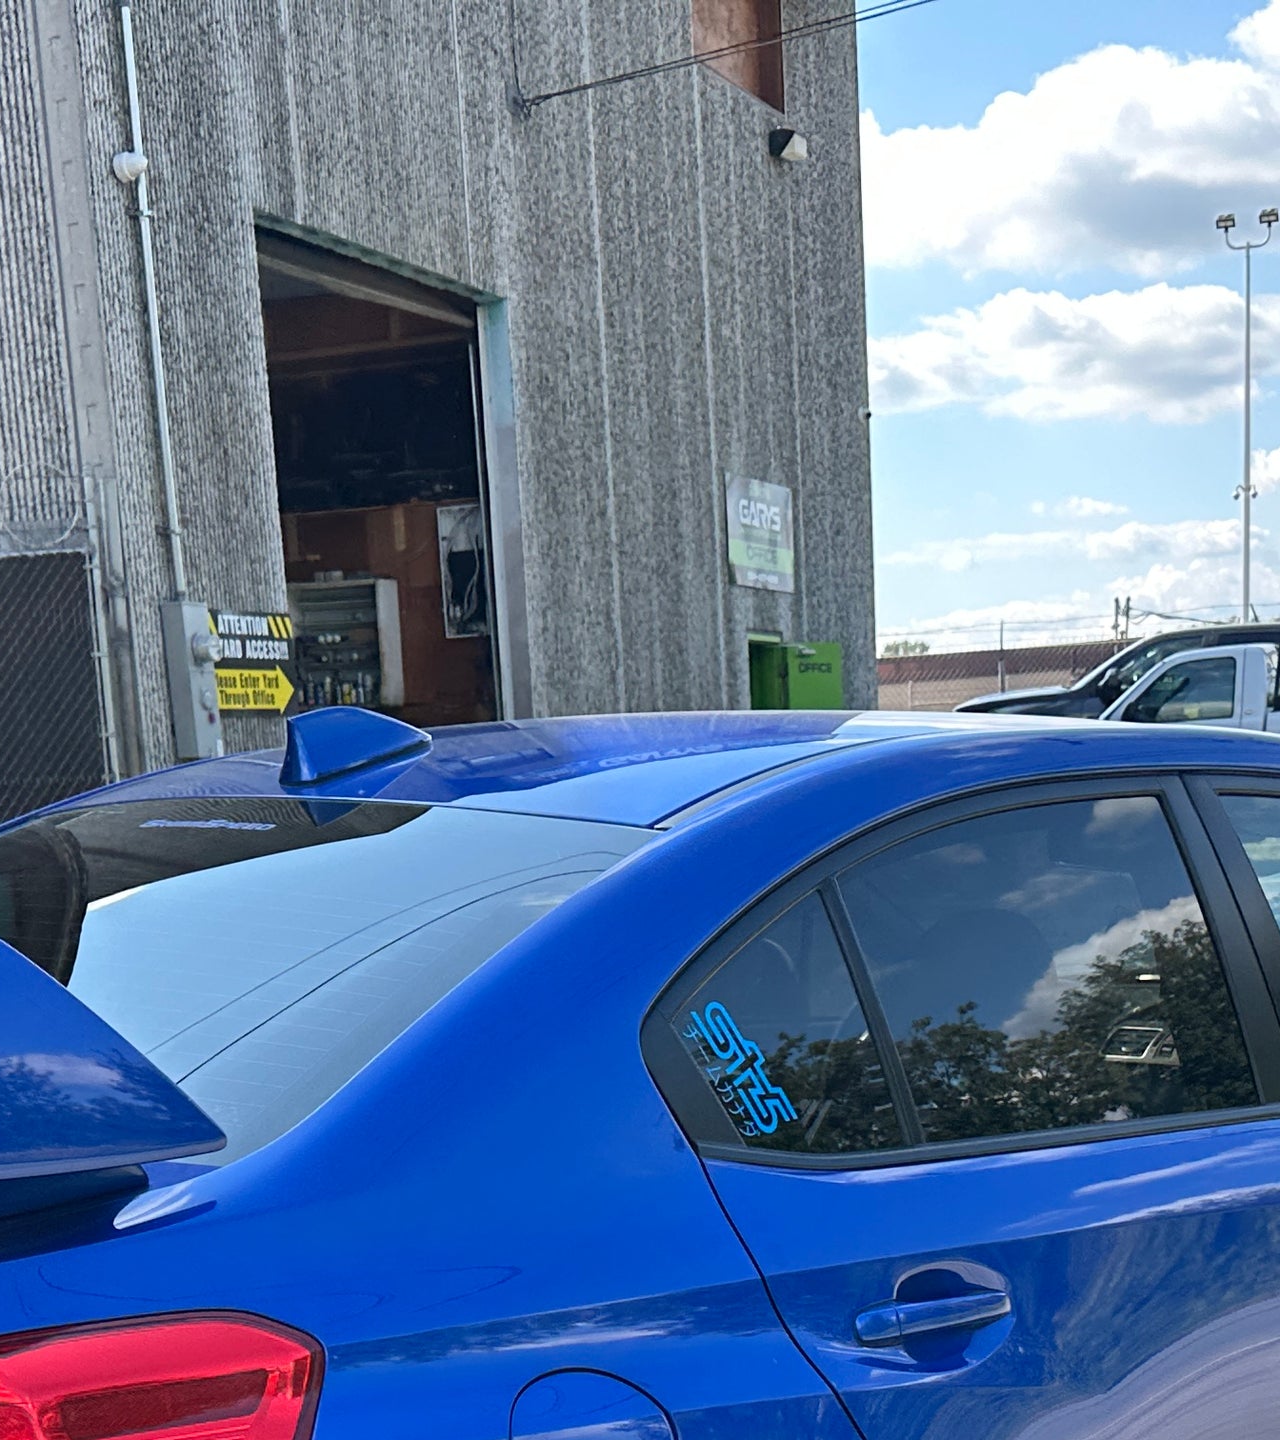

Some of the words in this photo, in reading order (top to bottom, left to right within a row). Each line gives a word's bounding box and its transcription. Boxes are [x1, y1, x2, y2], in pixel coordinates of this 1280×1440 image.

[217, 614, 269, 636] ATTENTION
[798, 660, 832, 674] OFFICE
[216, 672, 237, 688] lease
[239, 673, 260, 688] Enter
[262, 673, 279, 689] Yard
[219, 690, 250, 707] Through
[252, 691, 275, 705] Office
